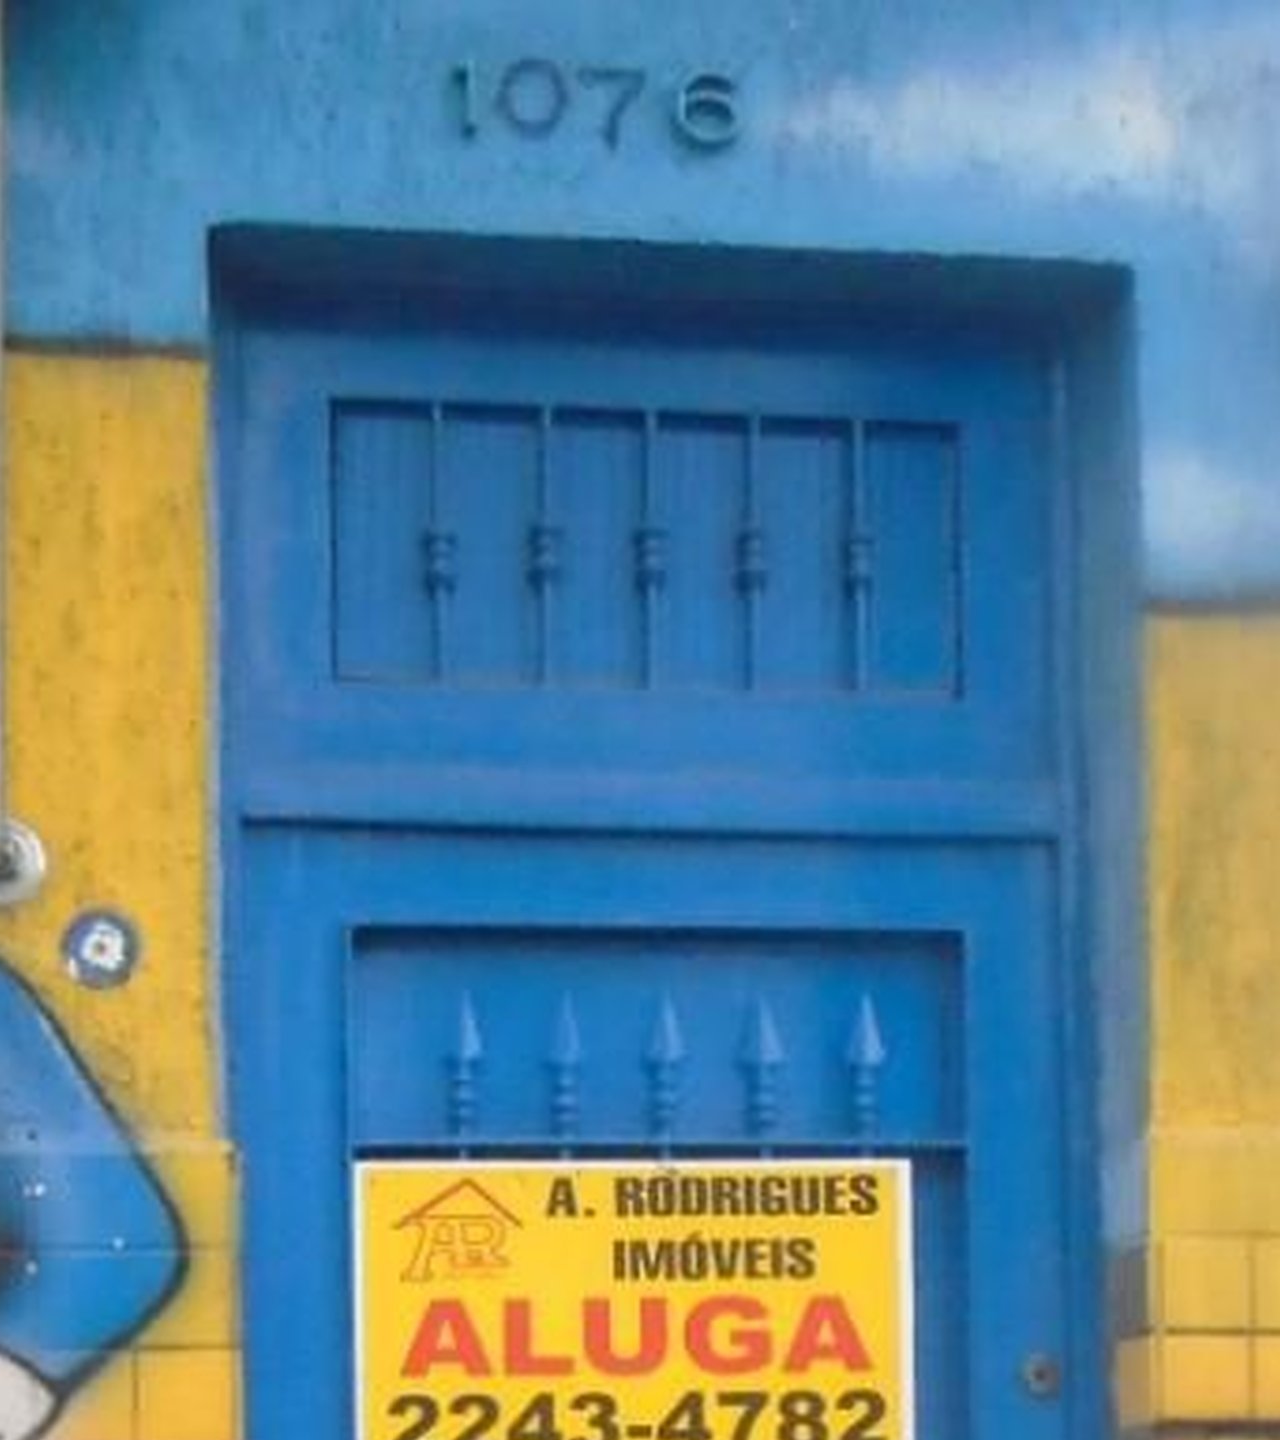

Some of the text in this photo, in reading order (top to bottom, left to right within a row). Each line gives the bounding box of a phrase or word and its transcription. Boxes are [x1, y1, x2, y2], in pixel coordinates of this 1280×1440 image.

[446, 56, 740, 154] 1076
[546, 1173, 879, 1219] A. RODRIGUES
[612, 1232, 817, 1282] IMÓVEIS
[400, 1294, 874, 1379] ALUGA
